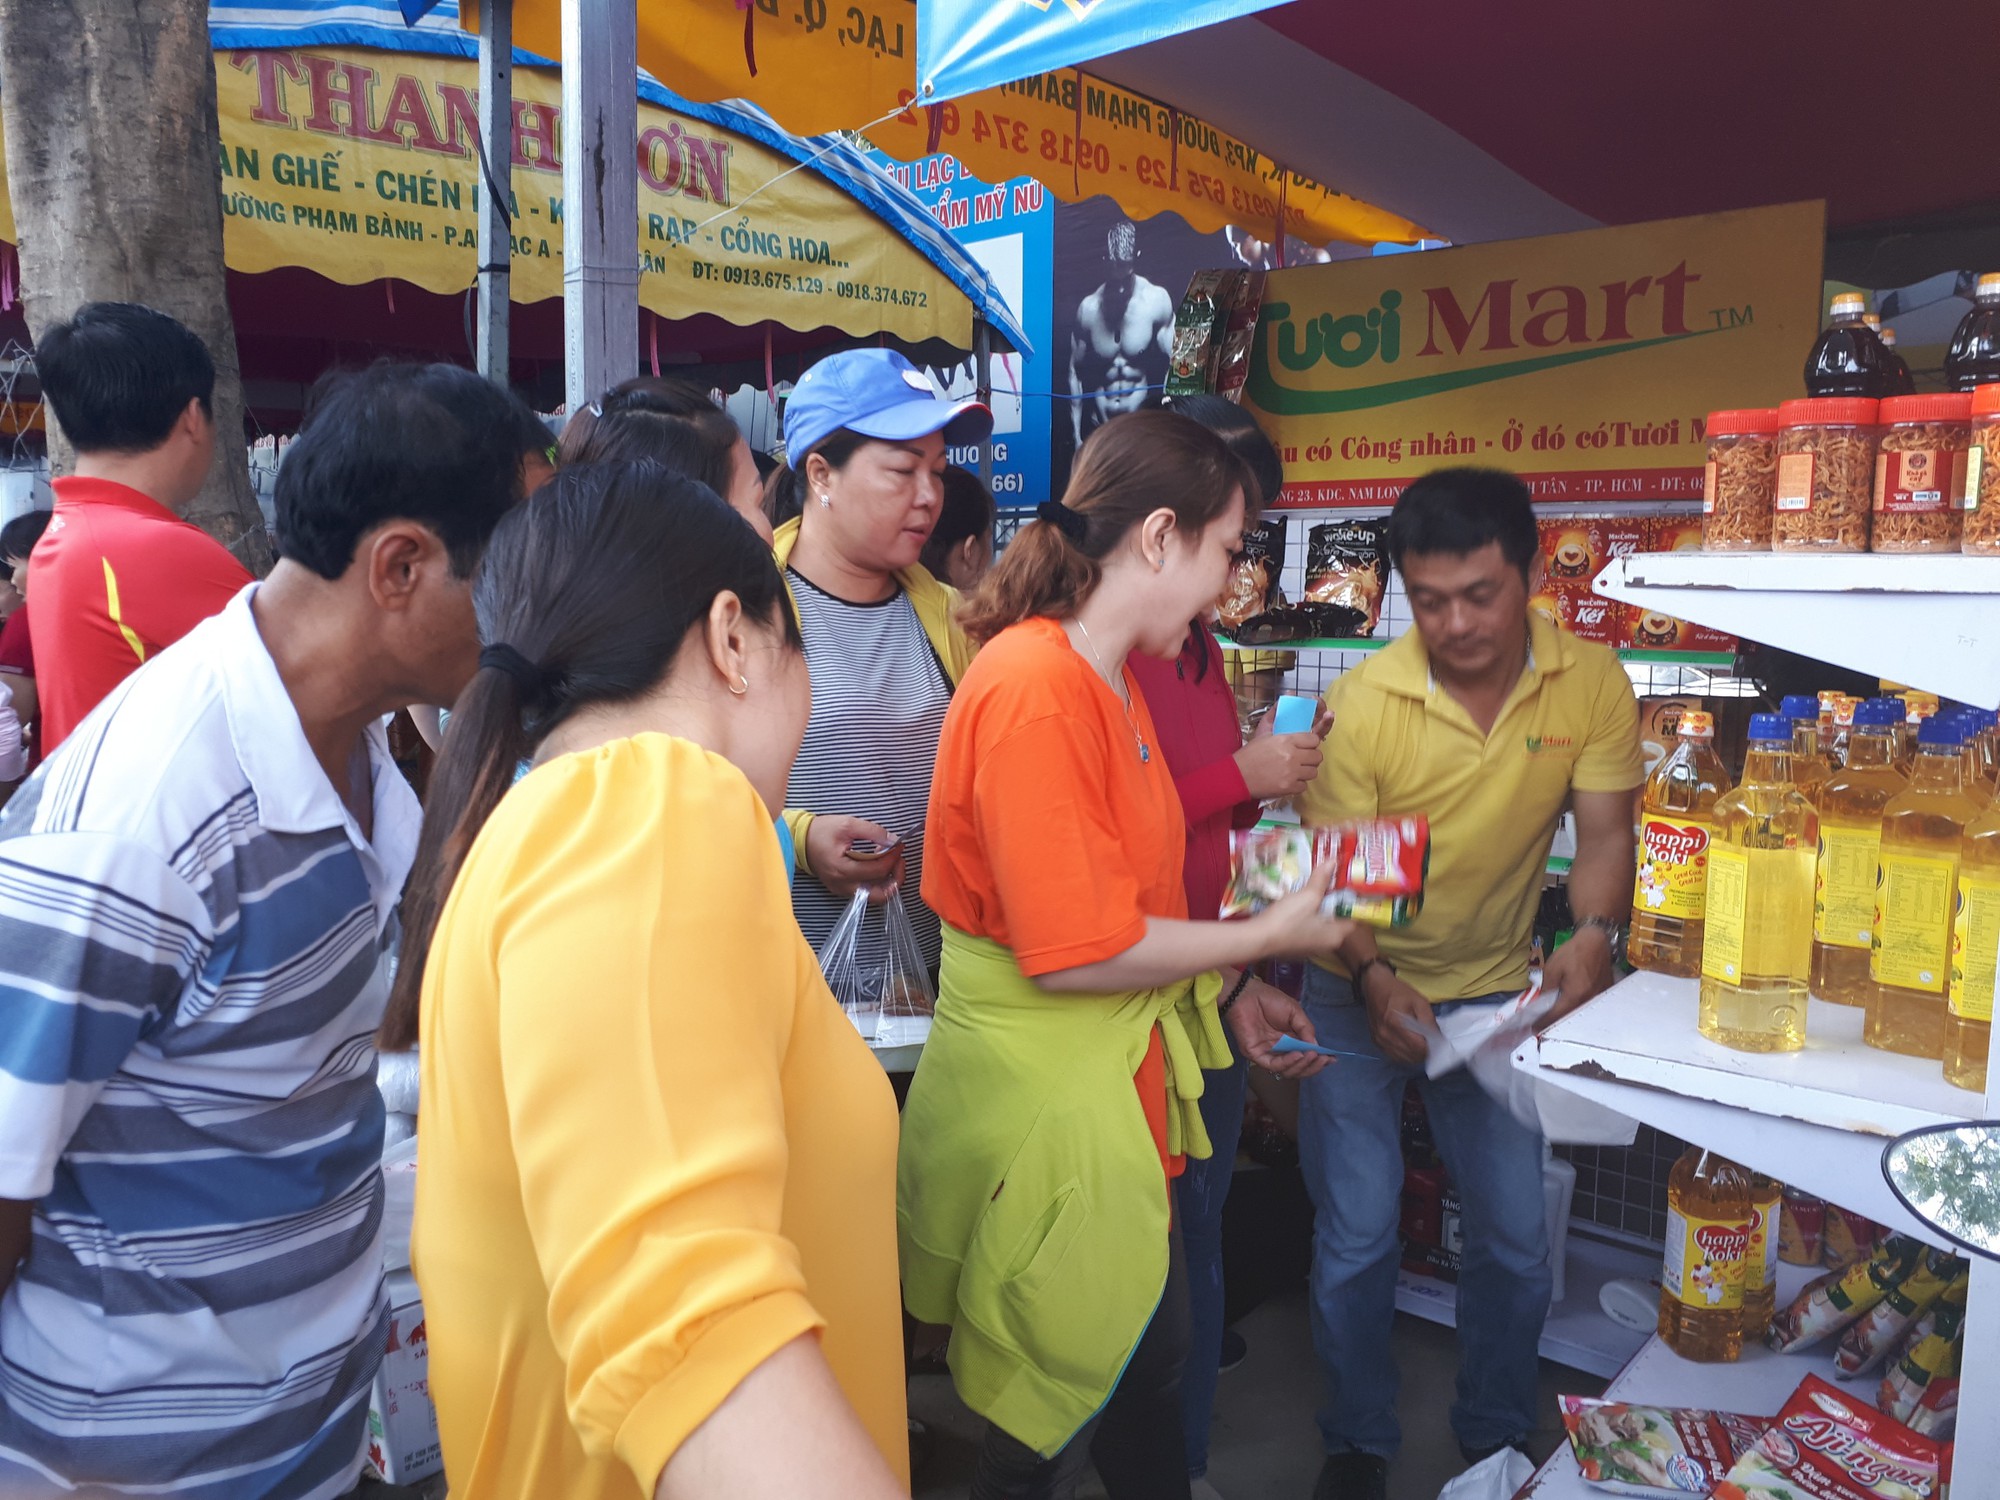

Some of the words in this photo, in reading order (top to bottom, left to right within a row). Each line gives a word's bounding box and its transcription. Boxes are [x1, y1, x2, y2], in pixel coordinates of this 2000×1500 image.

[272, 150, 343, 193] GHẾ
[354, 180, 366, 189] -
[375, 169, 460, 211] CHÉN
[636, 119, 732, 207] ƠN
[916, 156, 955, 192] LẠC
[222, 190, 287, 224] ƯỜNG
[292, 204, 358, 235] PHẠM
[365, 211, 424, 242] BÀNH
[975, 184, 1007, 223] MỸ
[537, 239, 551, 258] A
[648, 213, 698, 248] RẠP
[720, 216, 783, 258] CỔNG
[788, 237, 850, 268] HOA...
[638, 250, 666, 275] ÂN
[692, 261, 719, 281] ĐT:
[723, 265, 824, 295] 0913.675.129
[836, 281, 928, 309] 0918.374.672
[1416, 259, 1703, 357] Mart
[1708, 304, 1755, 331] TM
[1305, 437, 1333, 463] có
[1340, 436, 1403, 465] Công
[1410, 431, 1476, 457] nhân
[1502, 418, 1524, 452] Ở
[1531, 424, 1566, 451] đó
[1297, 490, 1314, 502] 23.
[1317, 488, 1345, 502] KDC.
[1349, 486, 1374, 500] NAM
[1540, 477, 1568, 494] TÂN
[1585, 478, 1606, 493] TP.
[1611, 478, 1643, 492] HCM
[1661, 477, 1686, 491] ĐT:
[1645, 826, 1702, 850] happi
[1646, 843, 1689, 866] Koki
[1703, 1246, 1742, 1262] Koki
[1784, 1416, 1932, 1491] Aji-ngon
